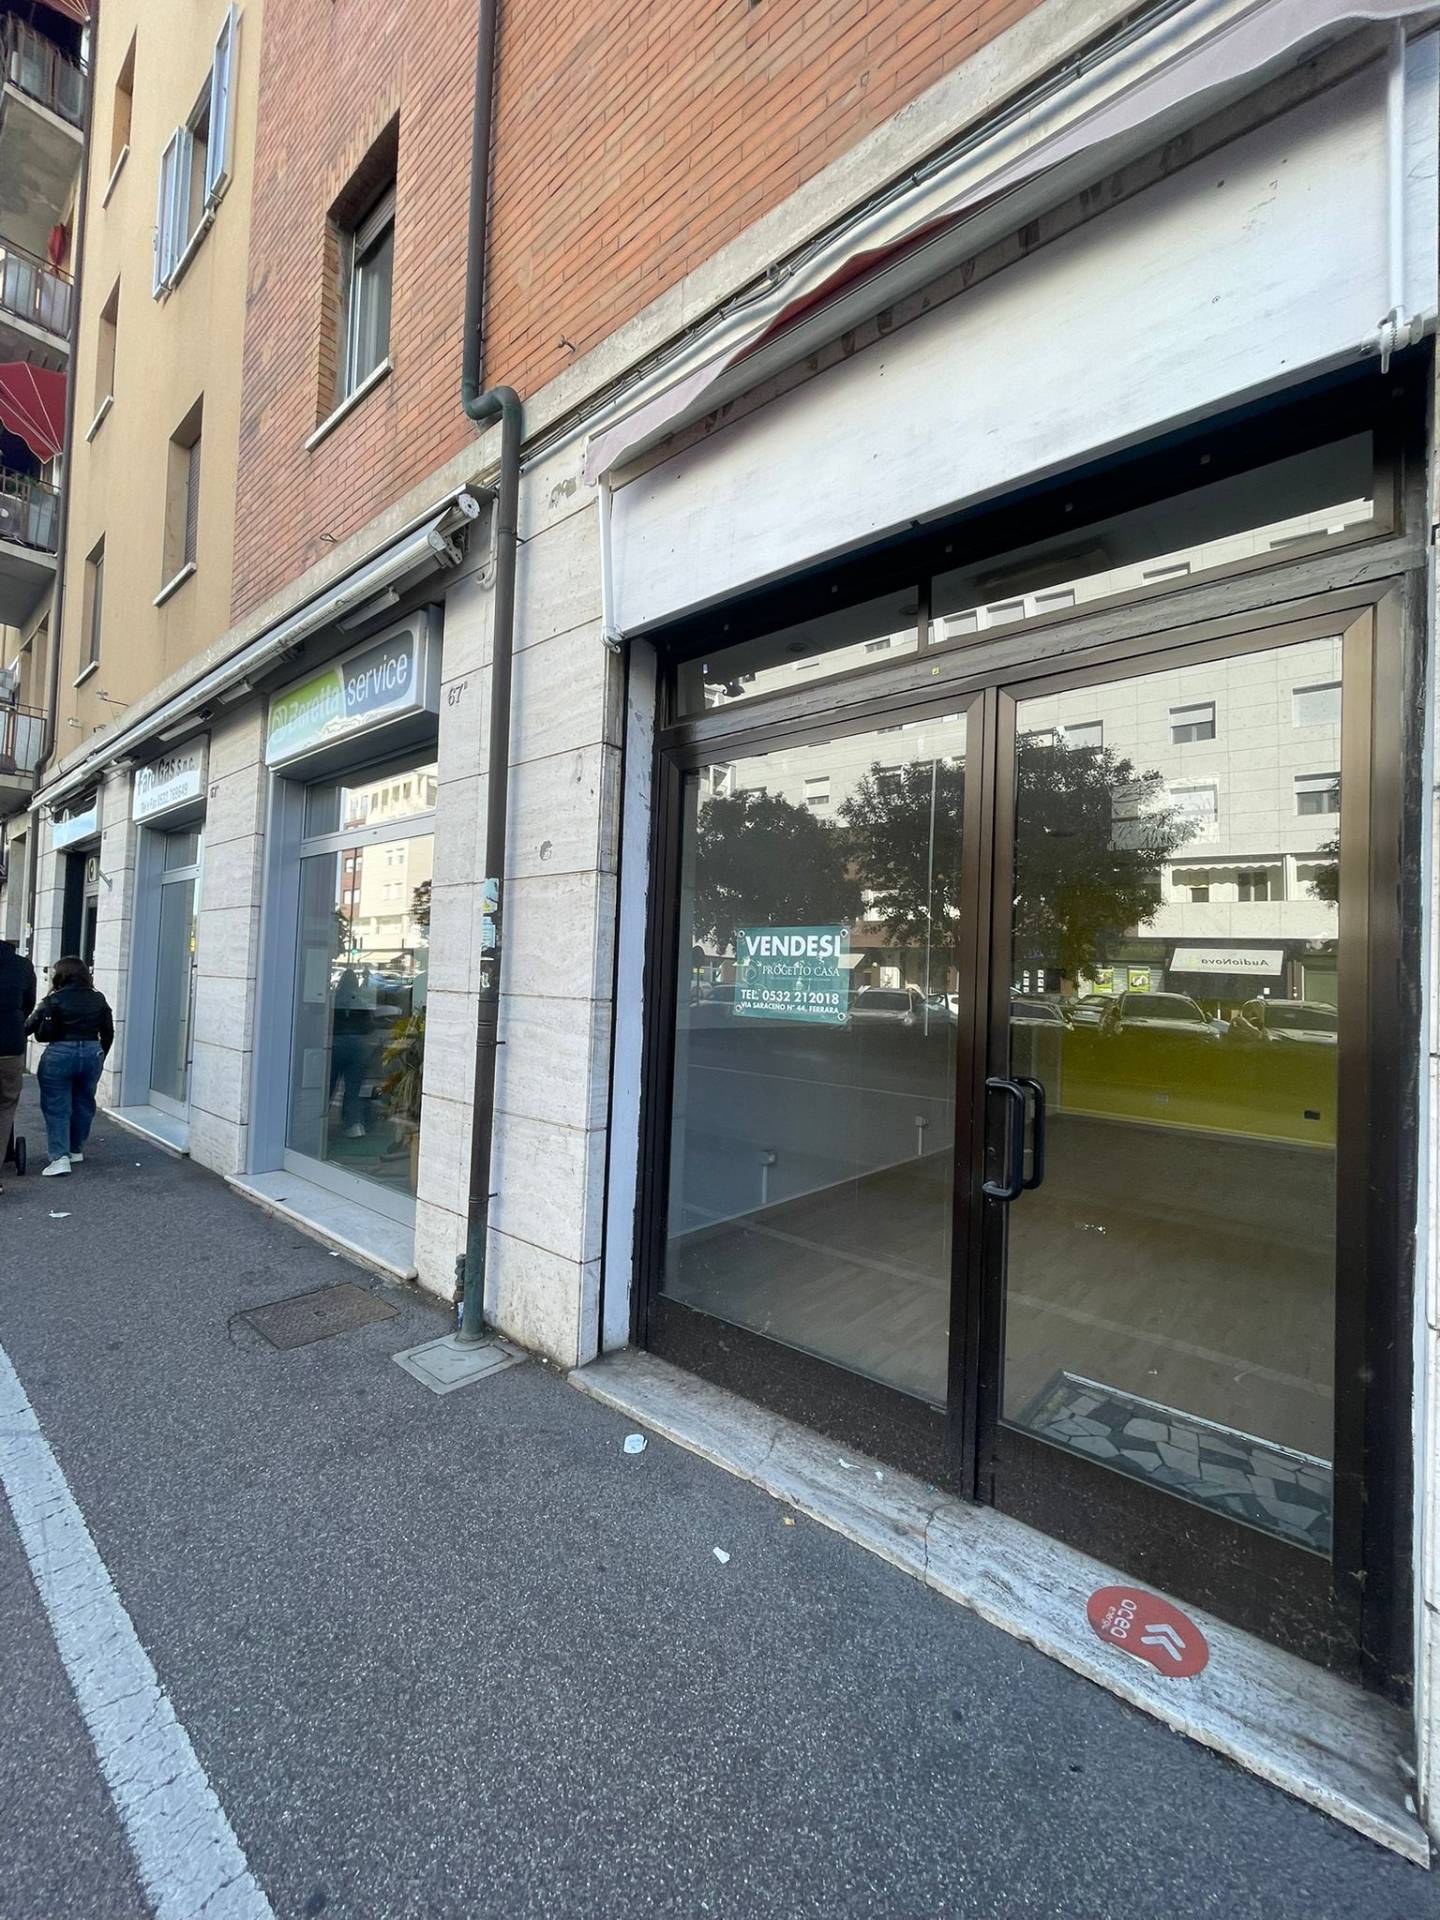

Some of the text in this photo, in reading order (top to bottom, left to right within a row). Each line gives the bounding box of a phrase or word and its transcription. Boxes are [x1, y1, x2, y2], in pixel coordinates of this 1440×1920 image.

[289, 653, 408, 734] Beretta service
[158, 758, 175, 783] Gas
[745, 935, 840, 957] VENDESI
[762, 965, 840, 977] PROGETTO CASA
[762, 990, 791, 1002] 0532
[794, 991, 840, 1005] 212018
[741, 1001, 752, 1009] VIA
[752, 1002, 786, 1011] SARACENO
[808, 1005, 839, 1014] FERRARA
